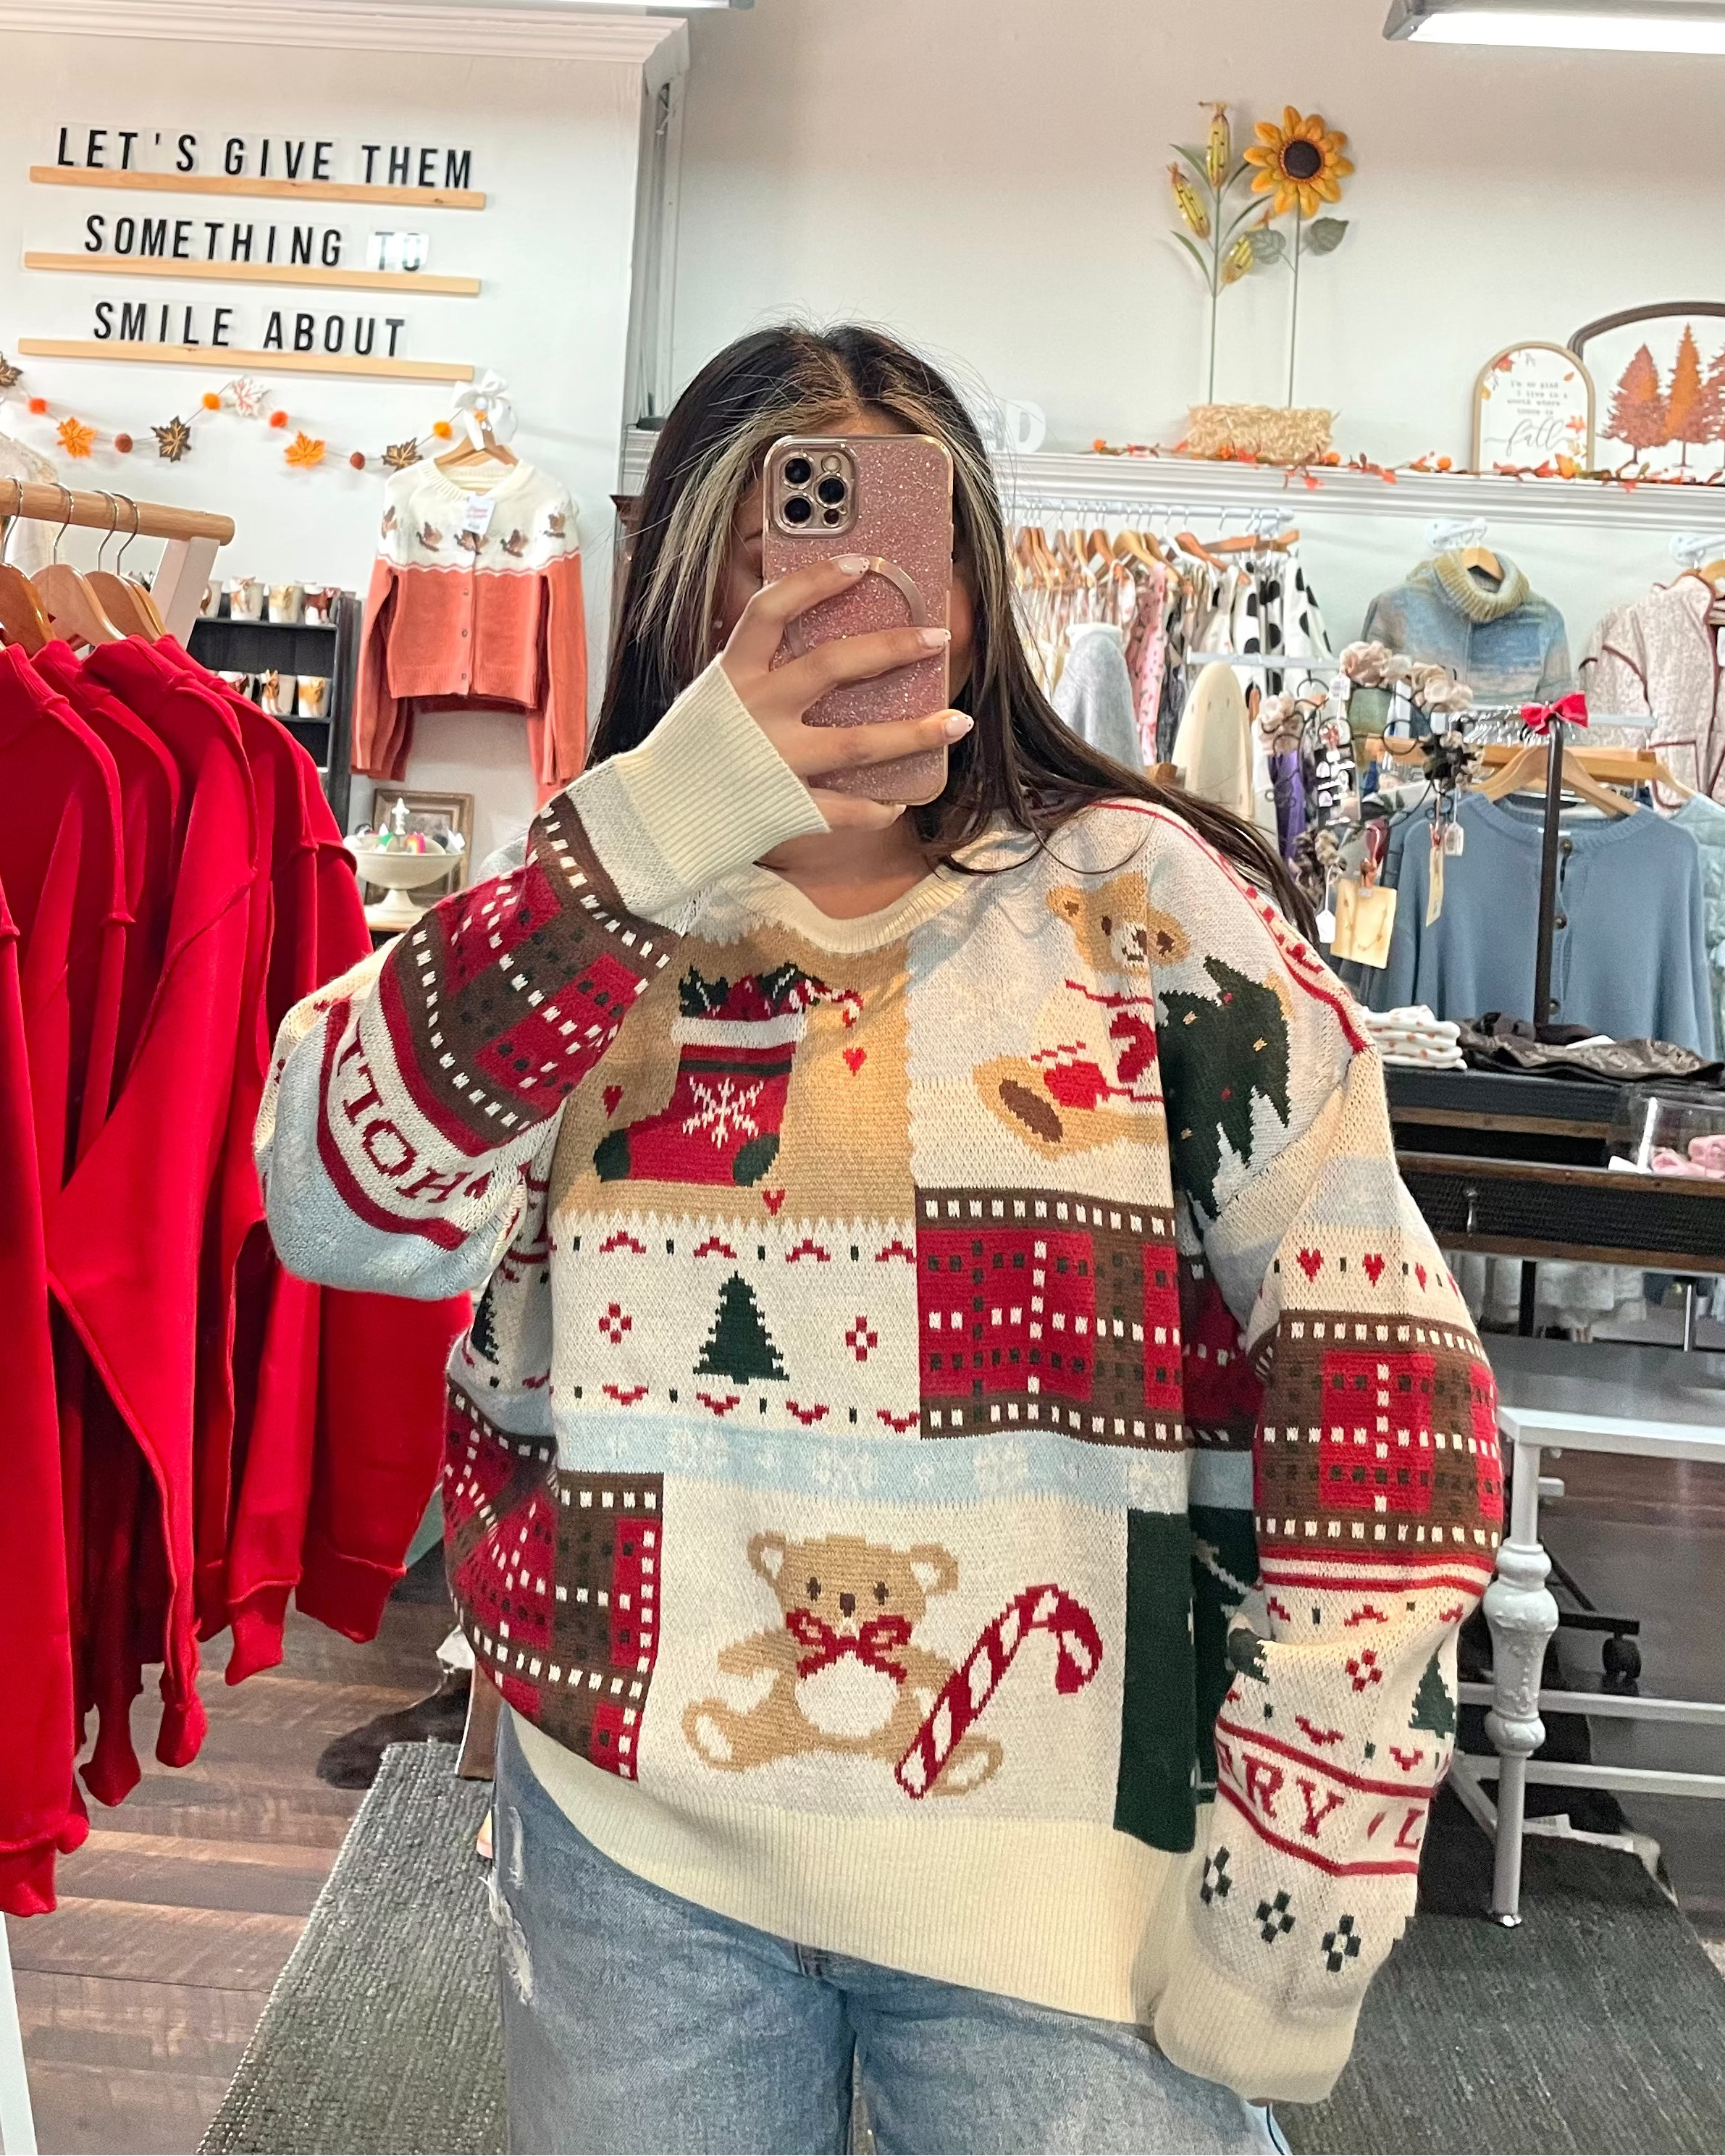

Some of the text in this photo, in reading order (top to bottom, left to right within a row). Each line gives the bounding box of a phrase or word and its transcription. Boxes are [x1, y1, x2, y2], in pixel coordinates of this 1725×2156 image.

[57, 127, 471, 190] LET'S GIVE THEM
[85, 214, 424, 272] SOMETHING TO
[93, 301, 405, 357] SMILE ABOUT
